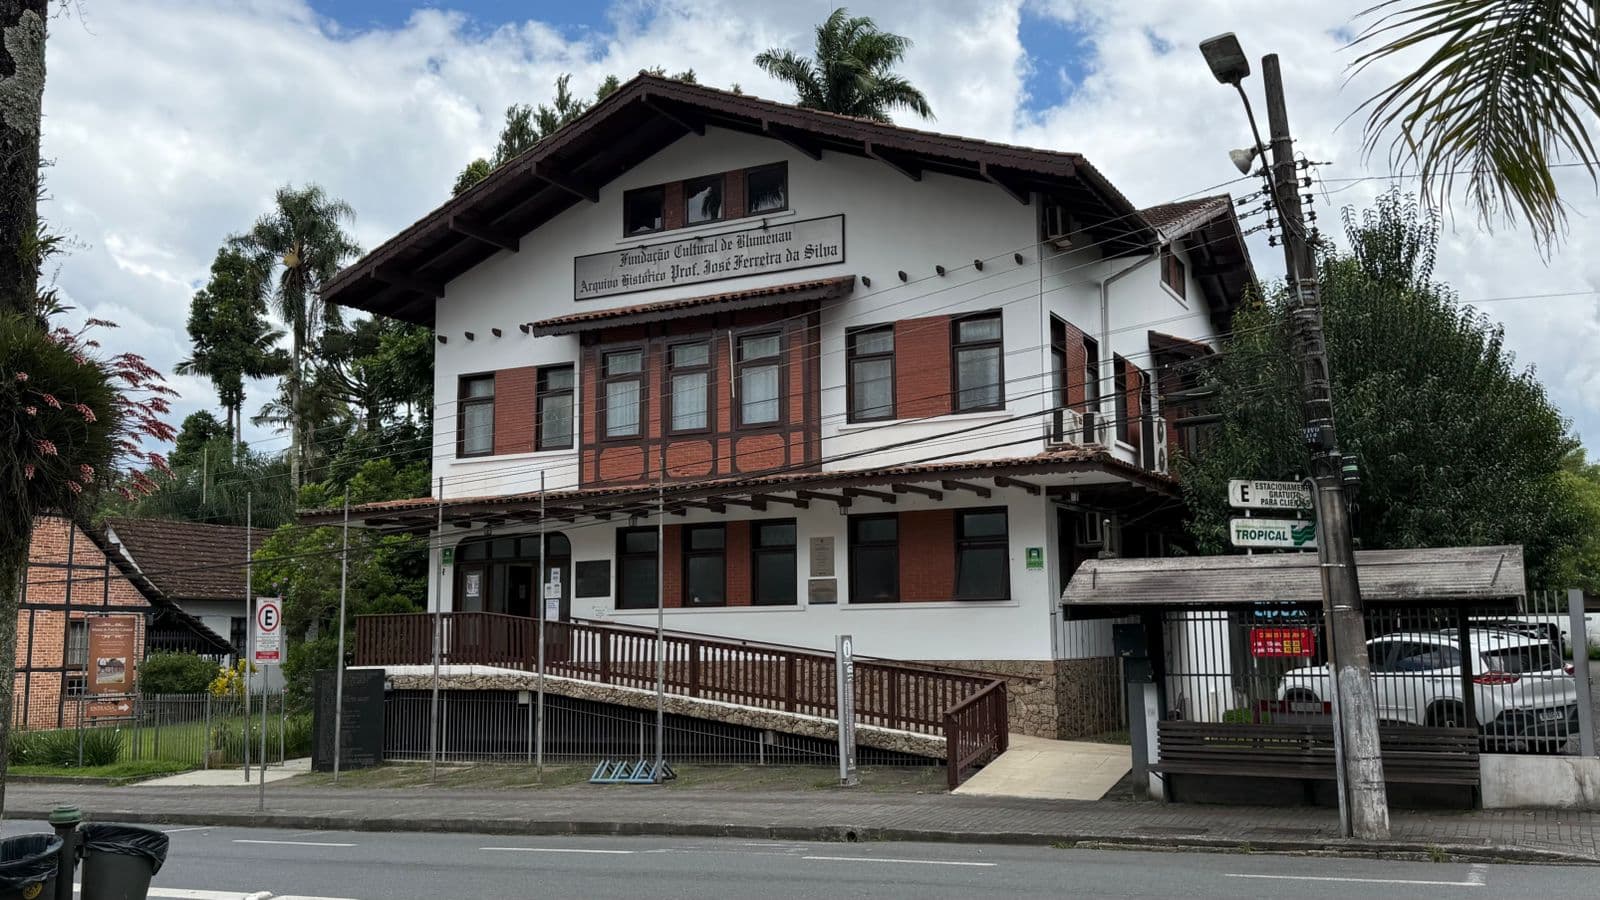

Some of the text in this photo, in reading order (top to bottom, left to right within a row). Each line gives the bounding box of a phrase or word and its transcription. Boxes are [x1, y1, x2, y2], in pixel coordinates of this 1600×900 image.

[620, 231, 792, 267] Fundação Cultural de Blumenau
[580, 243, 838, 293] Arquivo Histórico Prof. José Ferreira da Silva
[1240, 484, 1250, 503] E
[1260, 498, 1278, 506] PARA
[1235, 529, 1288, 541] TROPICAL
[265, 609, 273, 626] E
